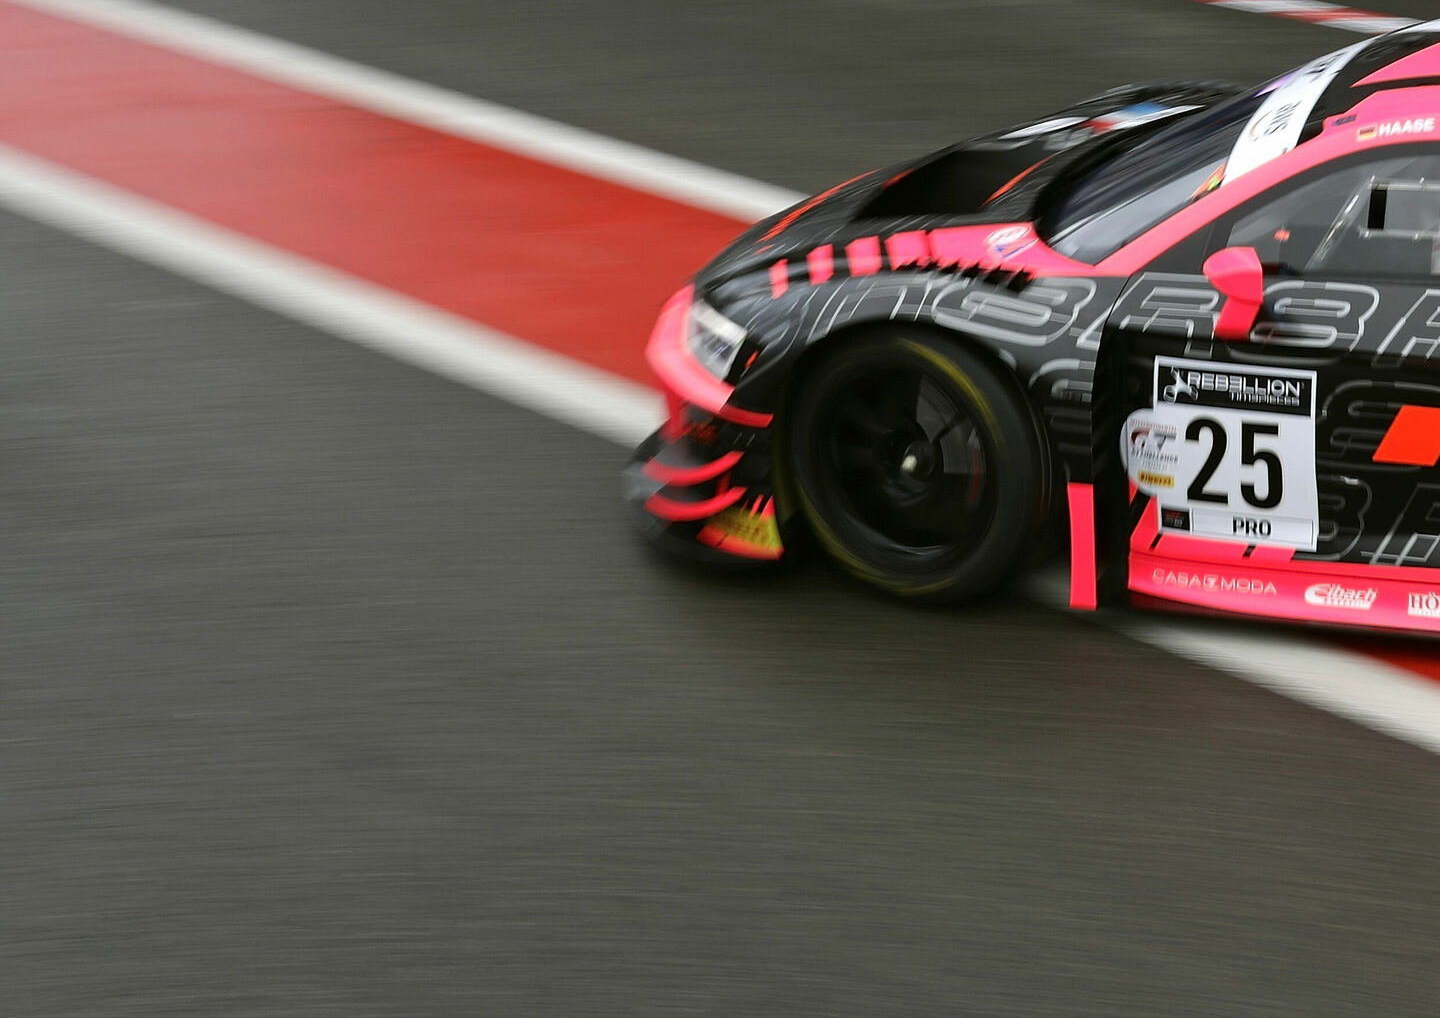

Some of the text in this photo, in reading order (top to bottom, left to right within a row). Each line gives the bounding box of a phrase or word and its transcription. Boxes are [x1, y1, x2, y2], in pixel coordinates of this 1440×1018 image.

[1378, 118, 1435, 138] HAASE
[1187, 371, 1300, 397] REBELLION
[1184, 416, 1284, 510] 25
[1232, 517, 1273, 537] PRO
[1152, 568, 1277, 596] CASA MODA
